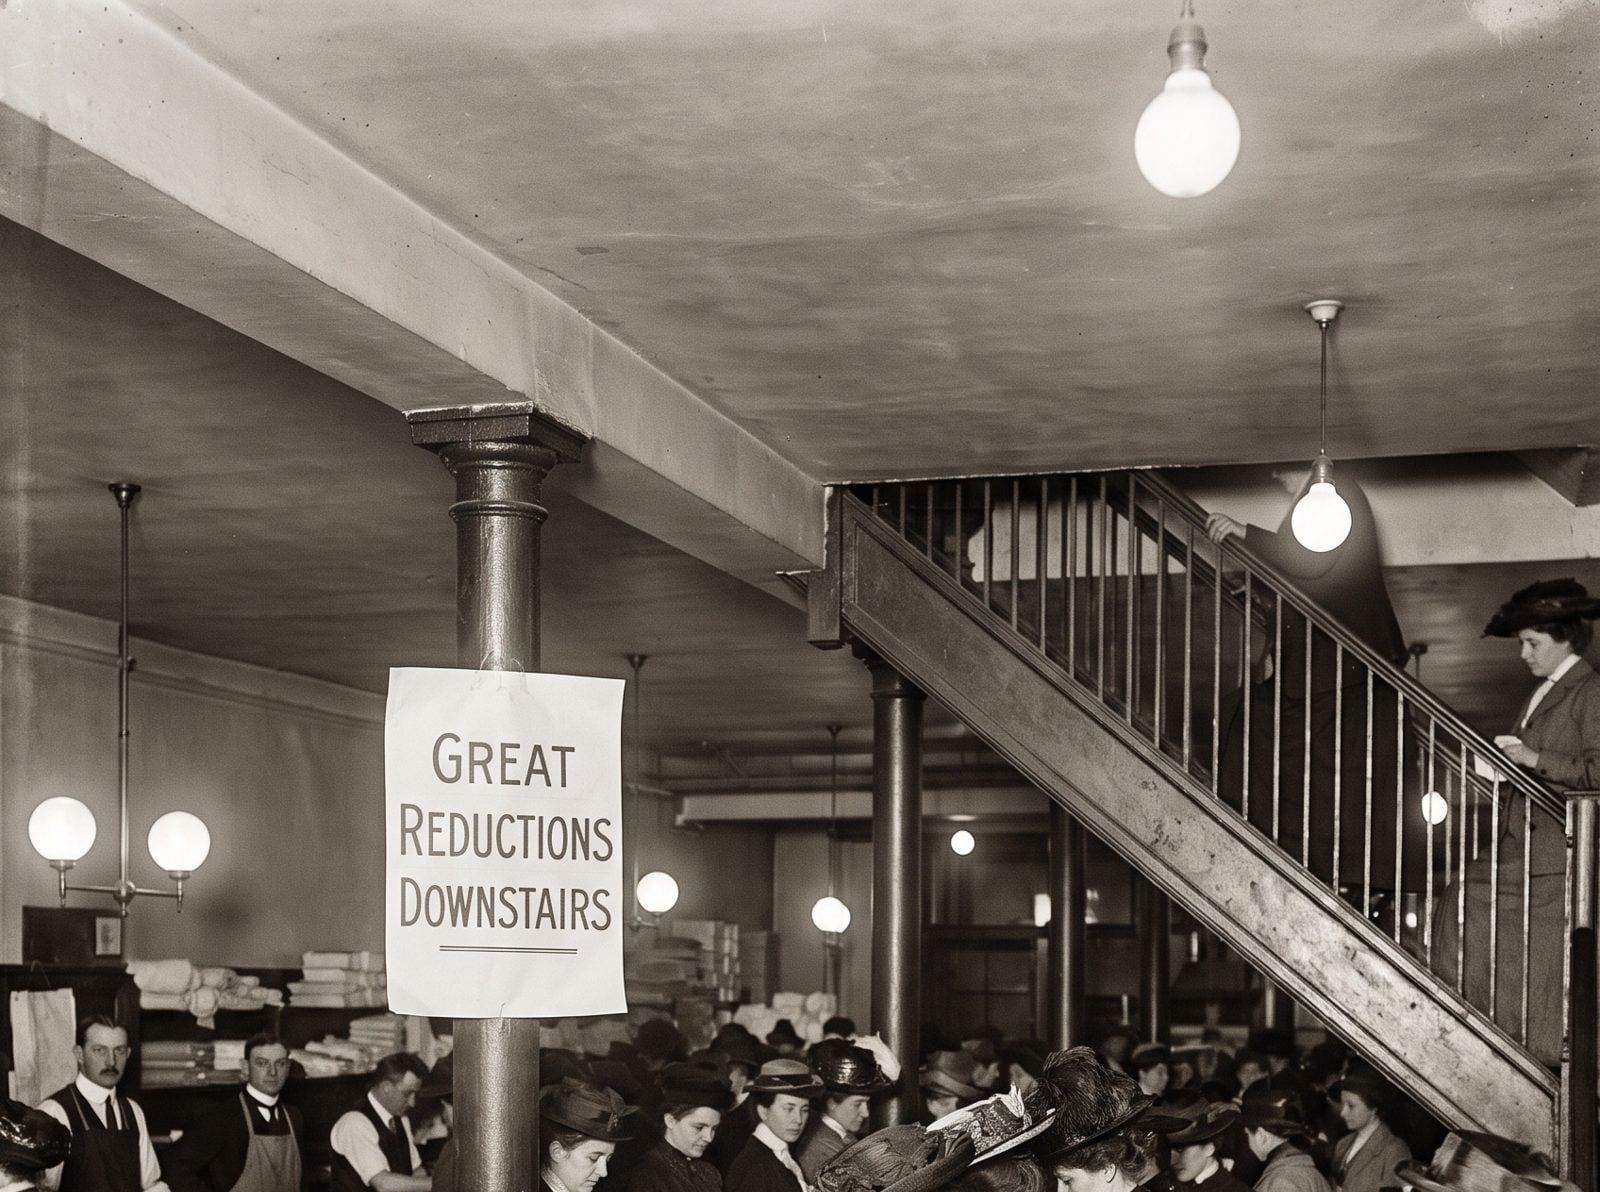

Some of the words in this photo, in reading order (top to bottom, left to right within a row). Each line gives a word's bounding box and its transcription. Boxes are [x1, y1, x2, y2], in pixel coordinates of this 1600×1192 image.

[432, 732, 576, 788] GREAT
[400, 803, 613, 862] REDUCTIONS
[400, 877, 612, 931] DOWNSTAIRS
